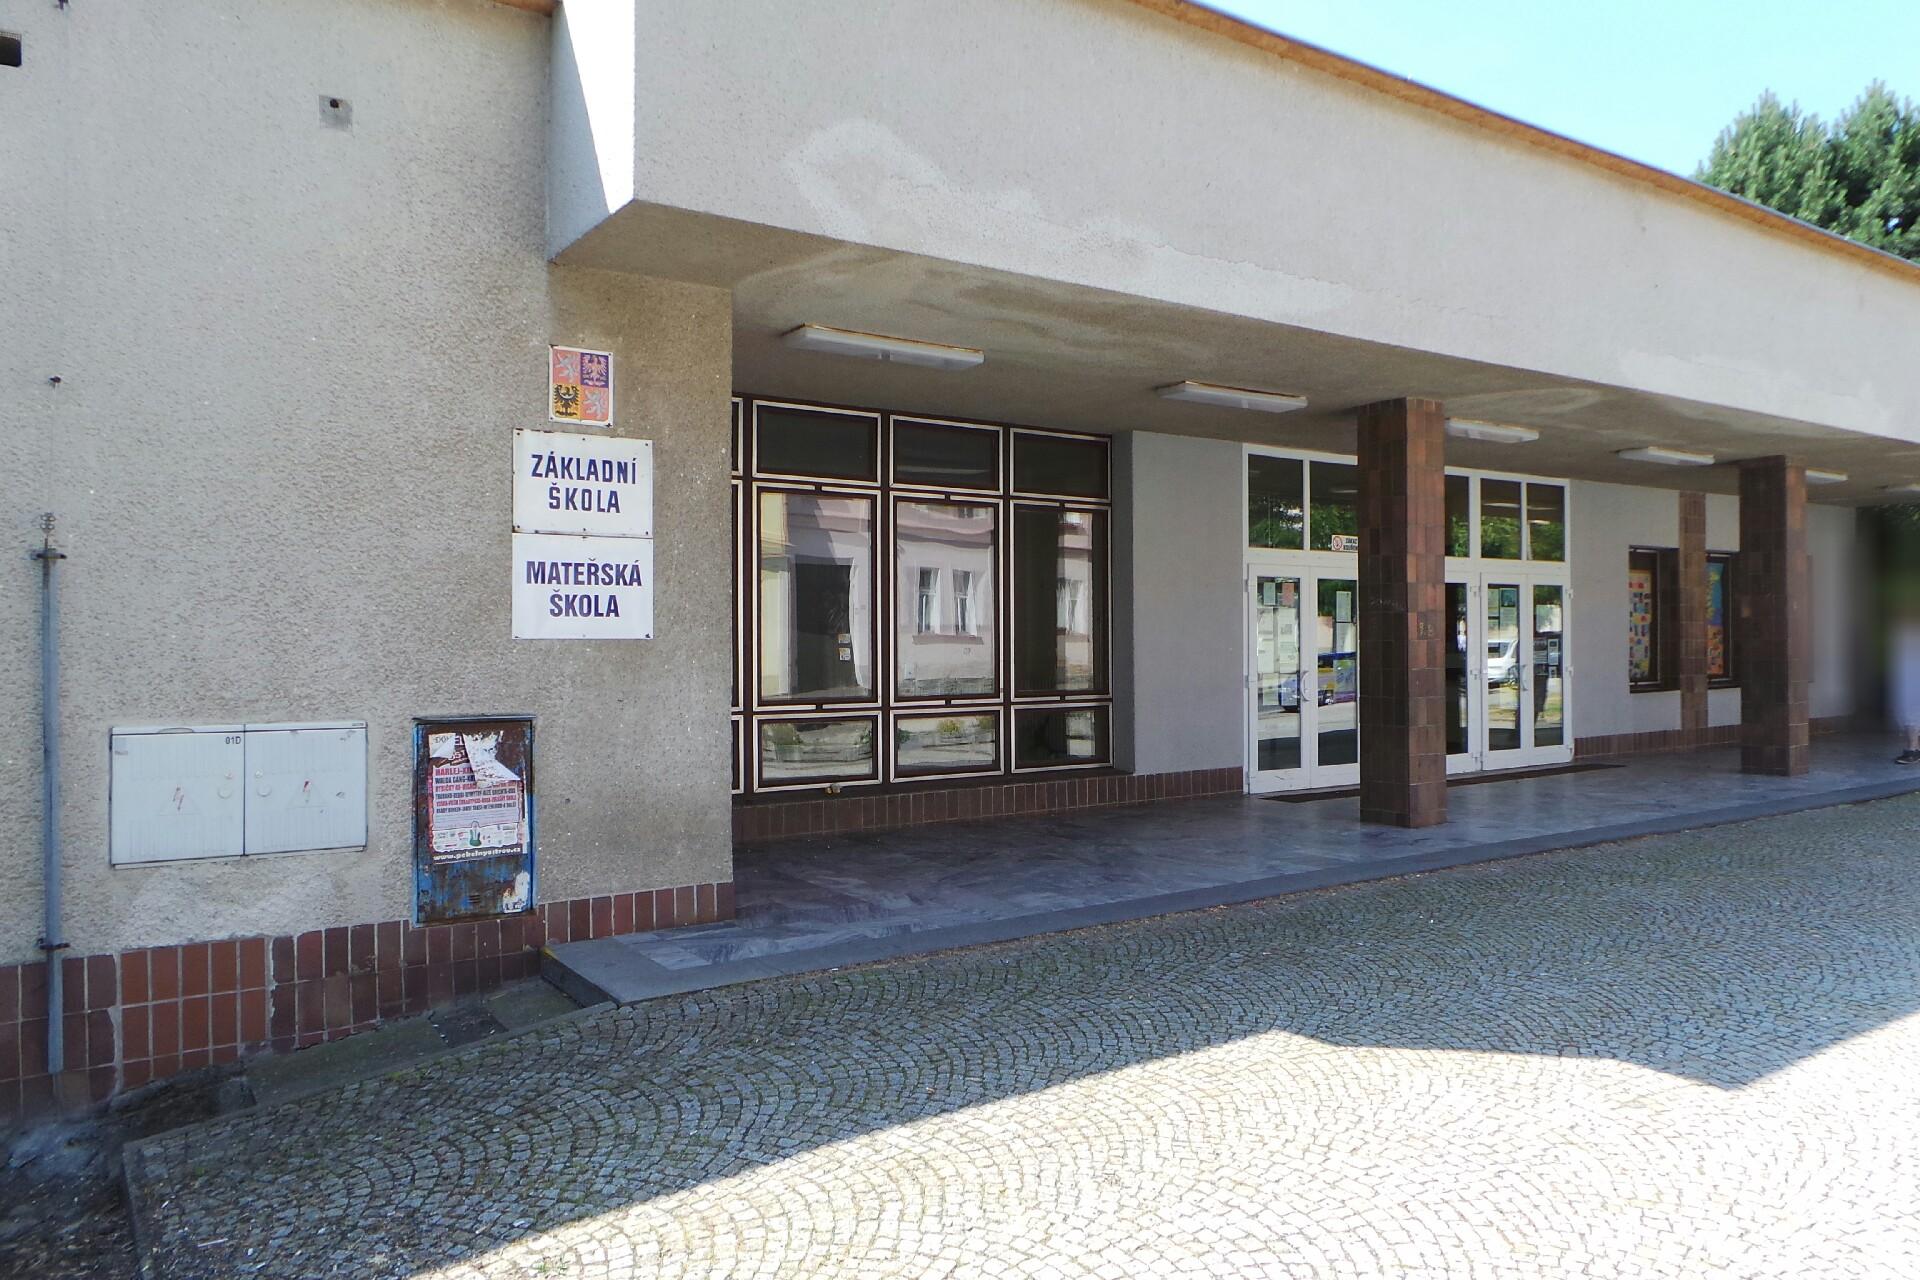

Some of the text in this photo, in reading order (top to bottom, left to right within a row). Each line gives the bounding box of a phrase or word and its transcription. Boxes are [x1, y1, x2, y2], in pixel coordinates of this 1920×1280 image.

[531, 451, 637, 484] ZÁKLADNÍ
[549, 482, 620, 513] ŠKOLA
[526, 557, 642, 586] MATEŘSKÁ
[549, 588, 620, 617] ŠKOLA
